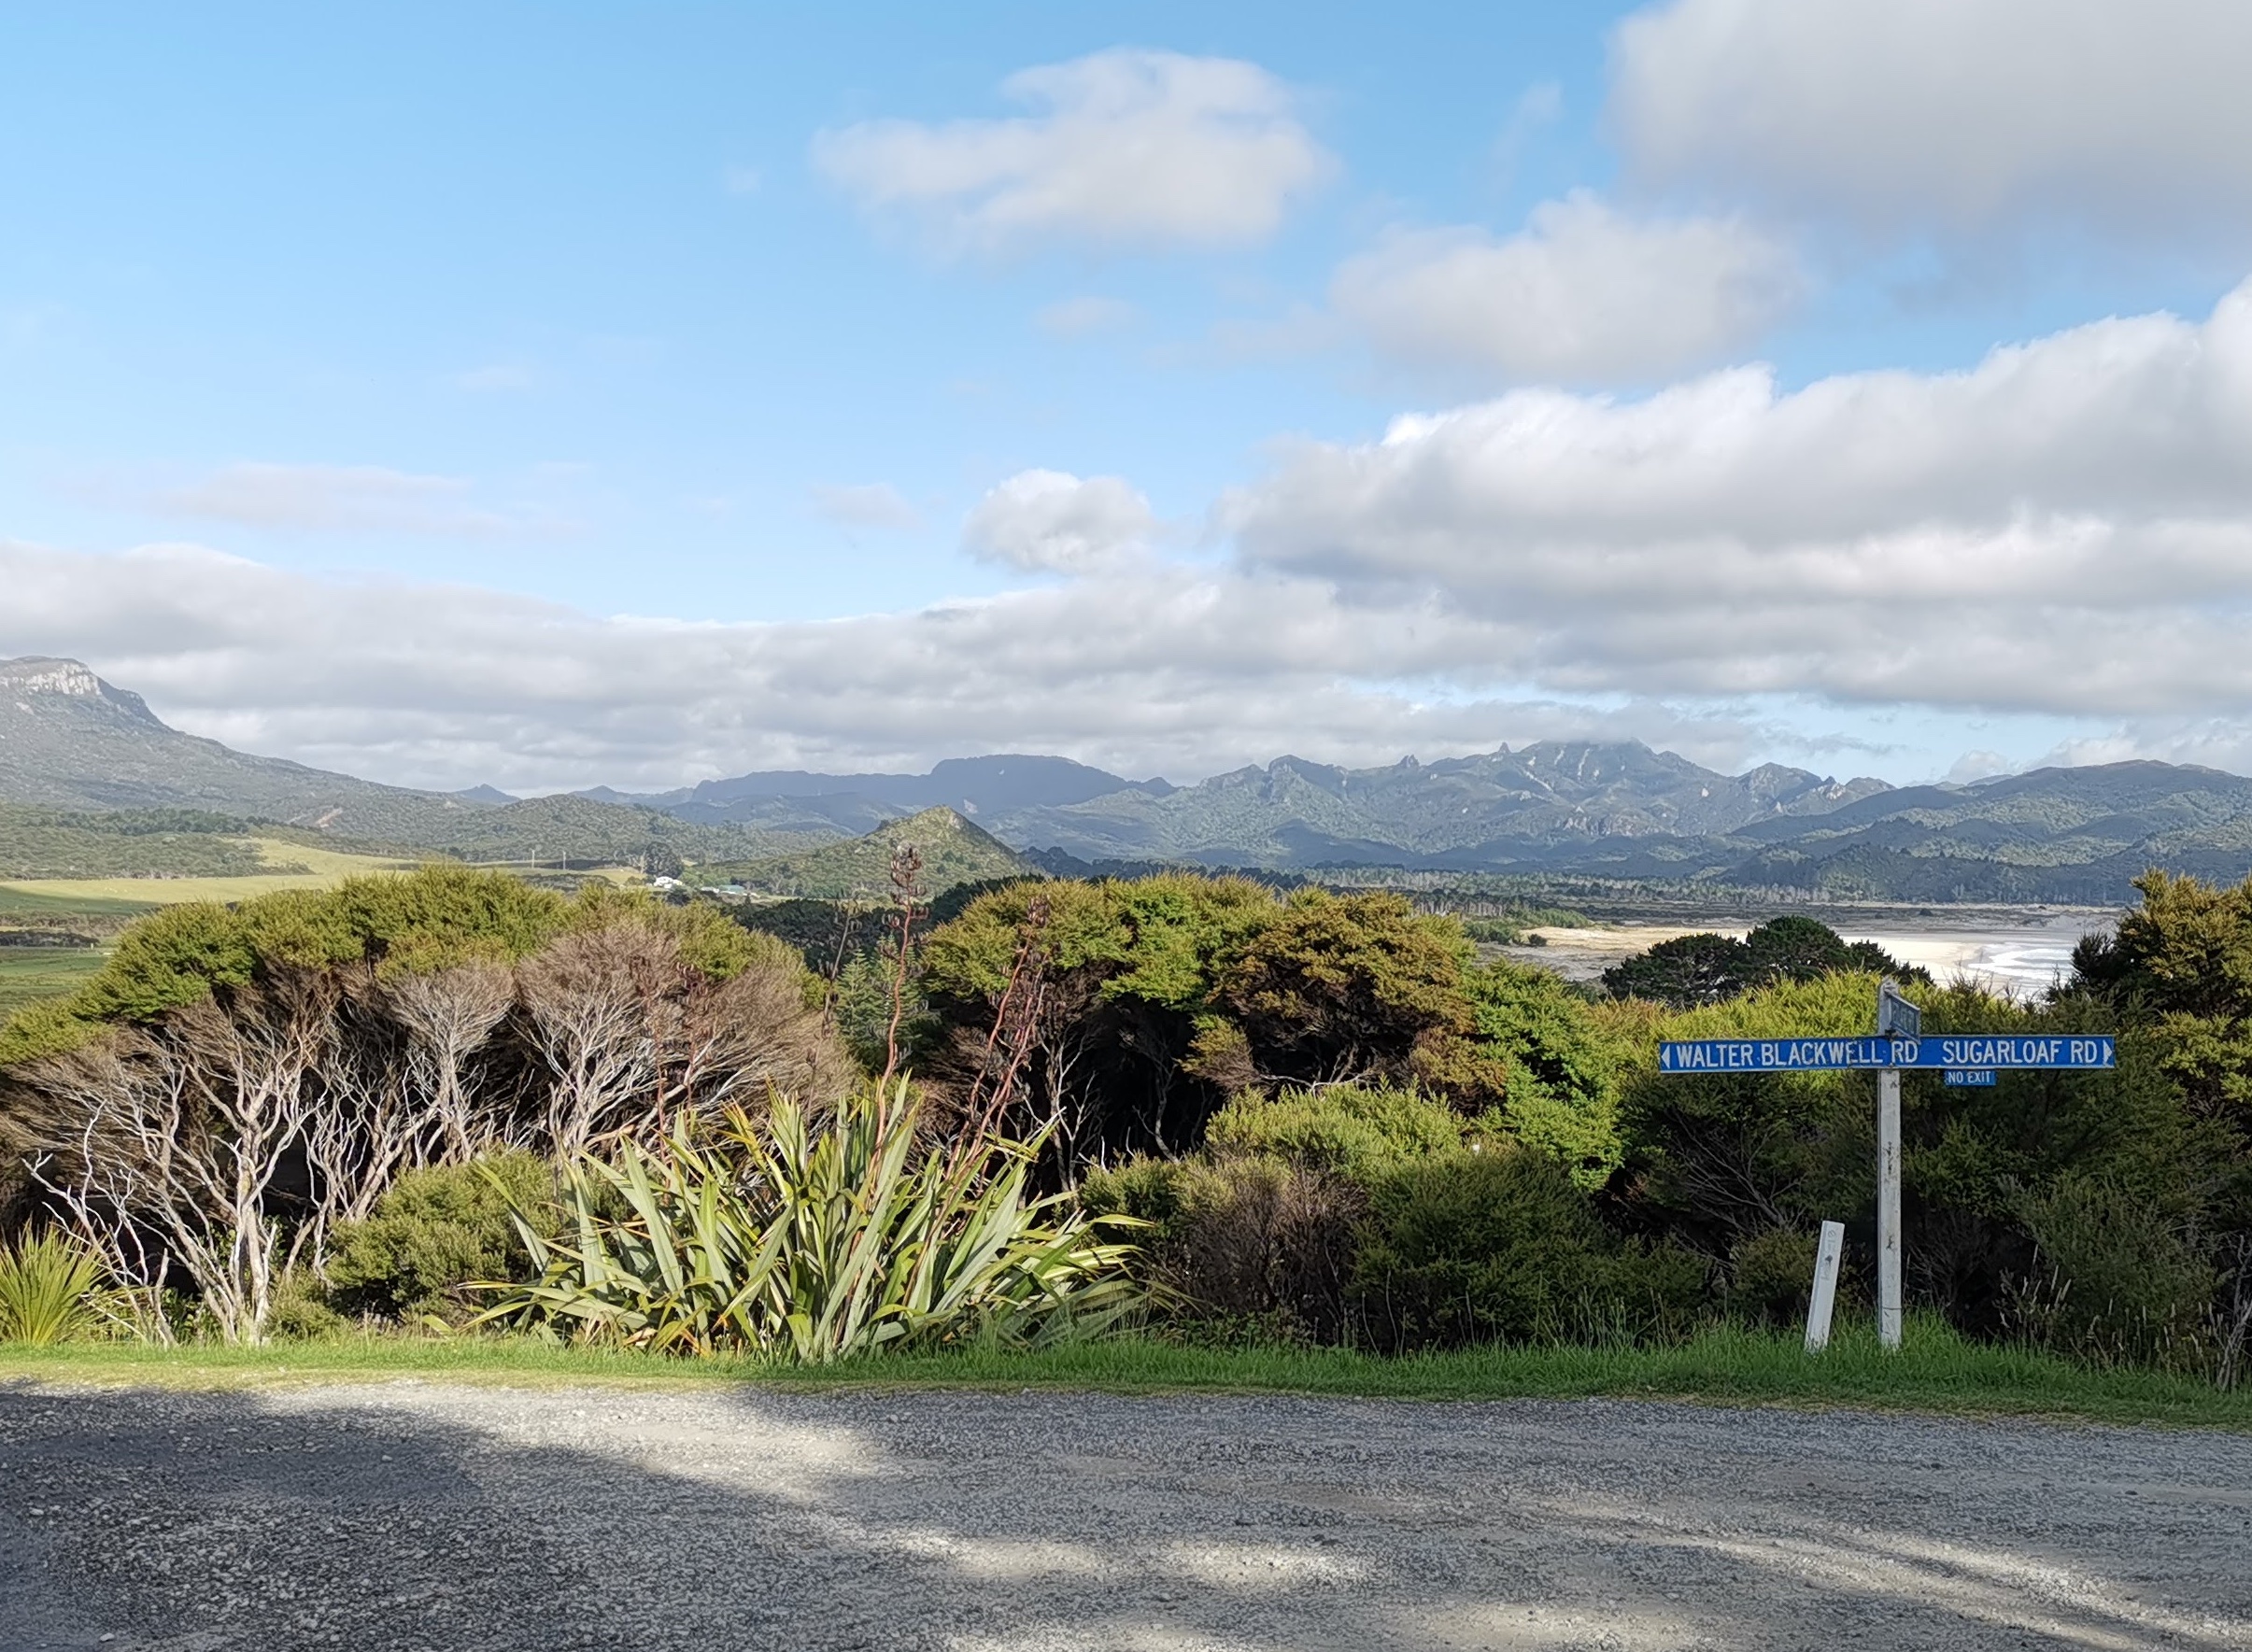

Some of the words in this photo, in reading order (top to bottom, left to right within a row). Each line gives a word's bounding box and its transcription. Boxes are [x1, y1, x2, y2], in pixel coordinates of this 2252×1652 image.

[1676, 1043, 1753, 1067] WALTER
[1761, 1040, 1883, 1066] BLACKWELL
[1891, 1040, 1919, 1064] RD
[1943, 1039, 2061, 1064] SUGARLOAF
[2070, 1040, 2098, 1063] RD
[1947, 1070, 1963, 1083] NO
[1967, 1071, 1990, 1083] EXIT
